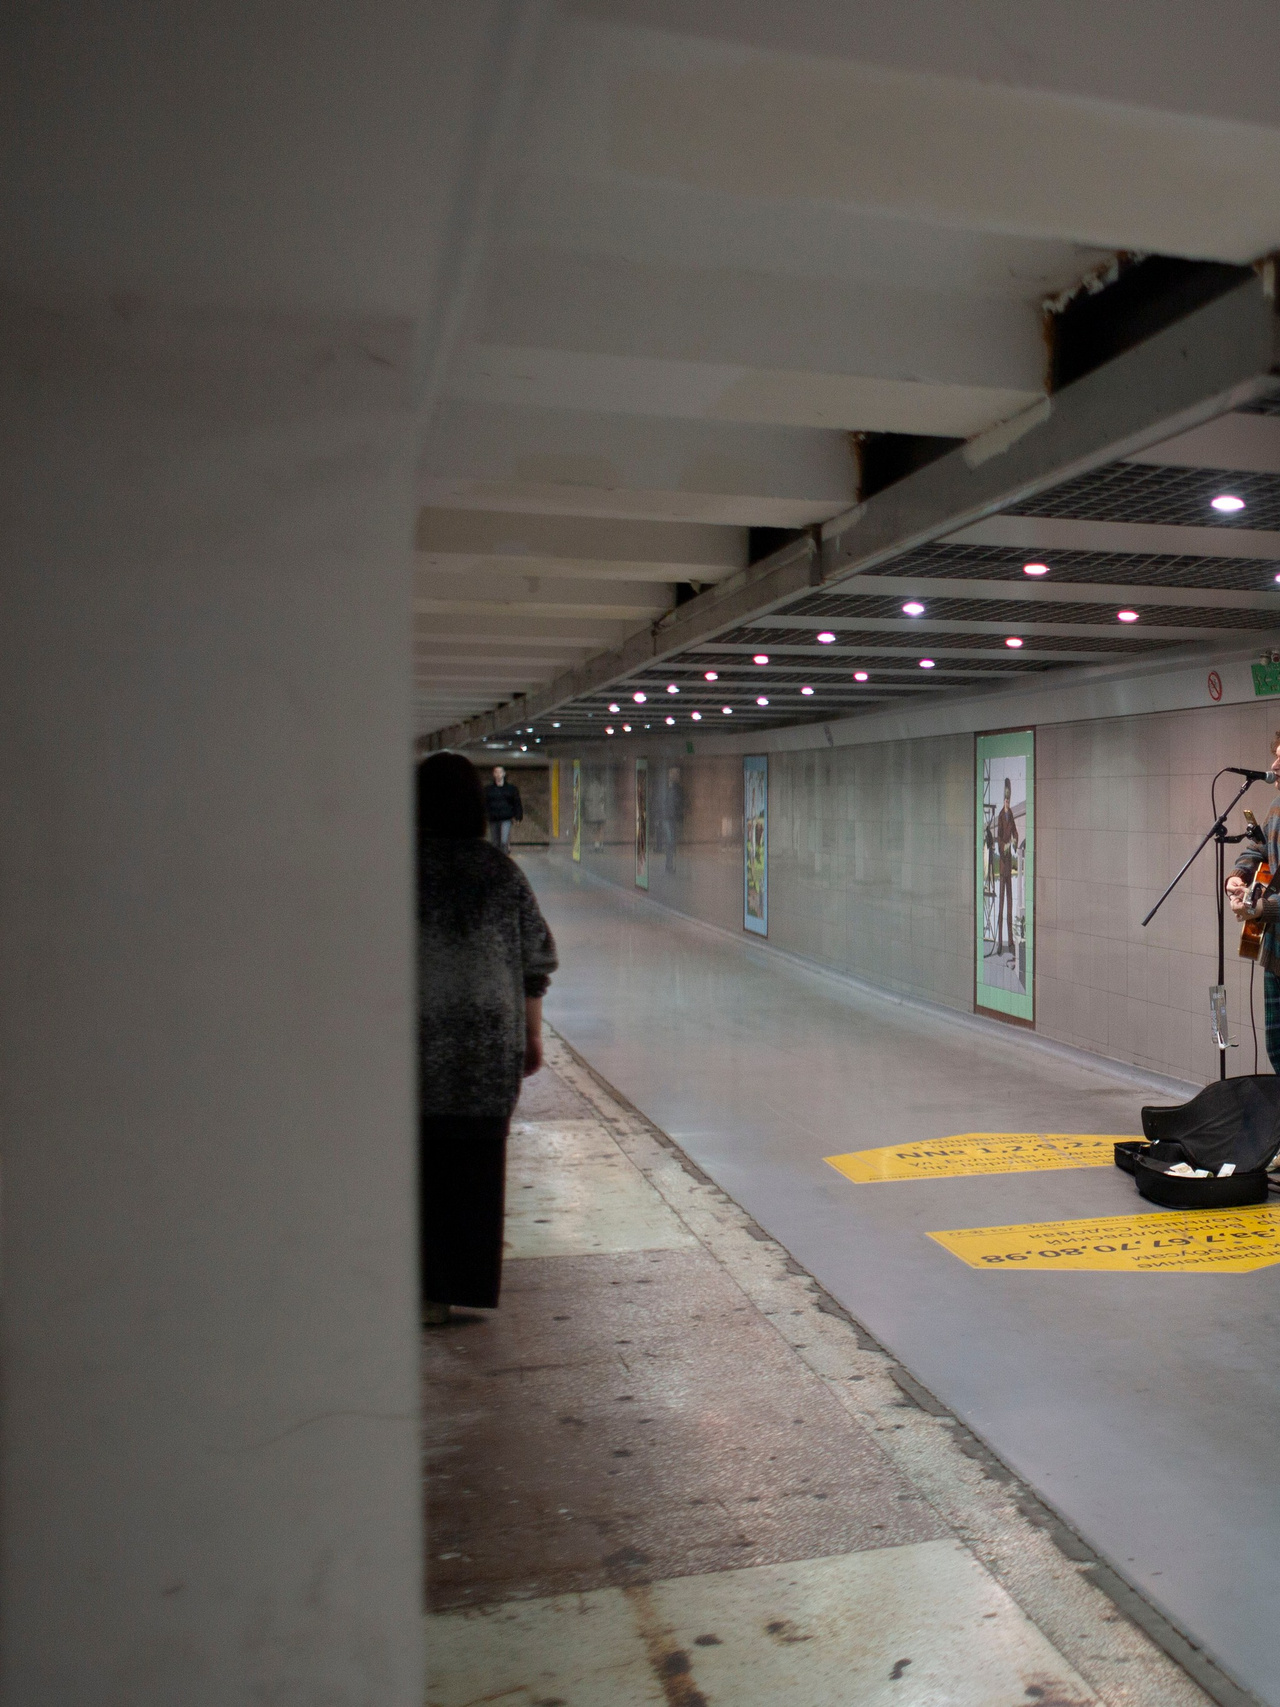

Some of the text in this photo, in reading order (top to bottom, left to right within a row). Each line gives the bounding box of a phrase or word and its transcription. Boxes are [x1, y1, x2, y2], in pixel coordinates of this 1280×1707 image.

[960, 1154, 1114, 1168] Ворошиловски
[1042, 1149, 1114, 1158] Садова
[1028, 1212, 1280, 1239] ул. Большая Садовая
[1045, 1222, 1247, 1246] Ворошиловский
[1130, 1244, 1264, 1262] автобусам
